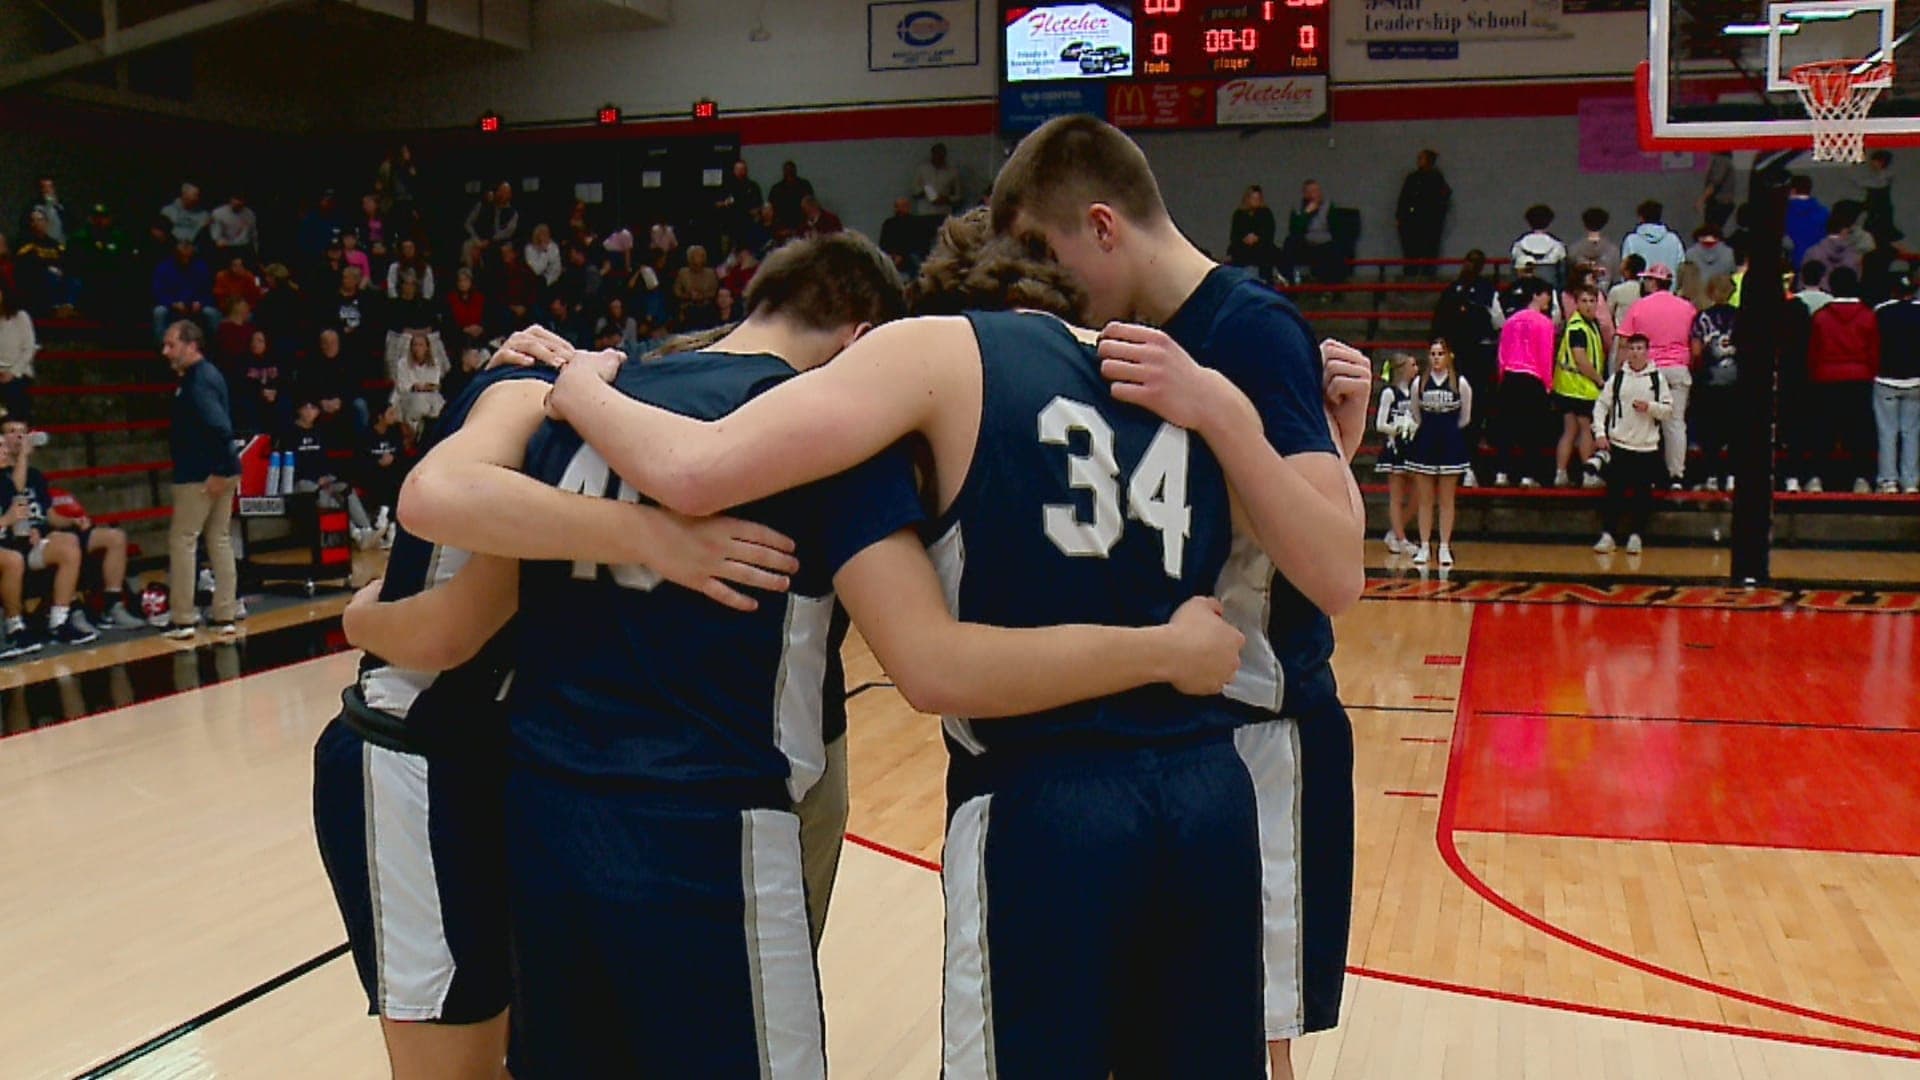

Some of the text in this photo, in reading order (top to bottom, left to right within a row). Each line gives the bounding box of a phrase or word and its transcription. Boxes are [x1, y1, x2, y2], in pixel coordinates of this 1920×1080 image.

[1028, 11, 1109, 36] Fletcher
[1365, 9, 1527, 34] Leadership School
[1154, 33, 1168, 55] 0
[1300, 25, 1314, 48] 0
[1214, 57, 1250, 71] player
[1227, 79, 1313, 106] Fletcher
[600, 108, 616, 123] EXIT
[696, 103, 712, 117] EXIT
[482, 117, 498, 132] EXIT
[1037, 395, 1192, 580] 34
